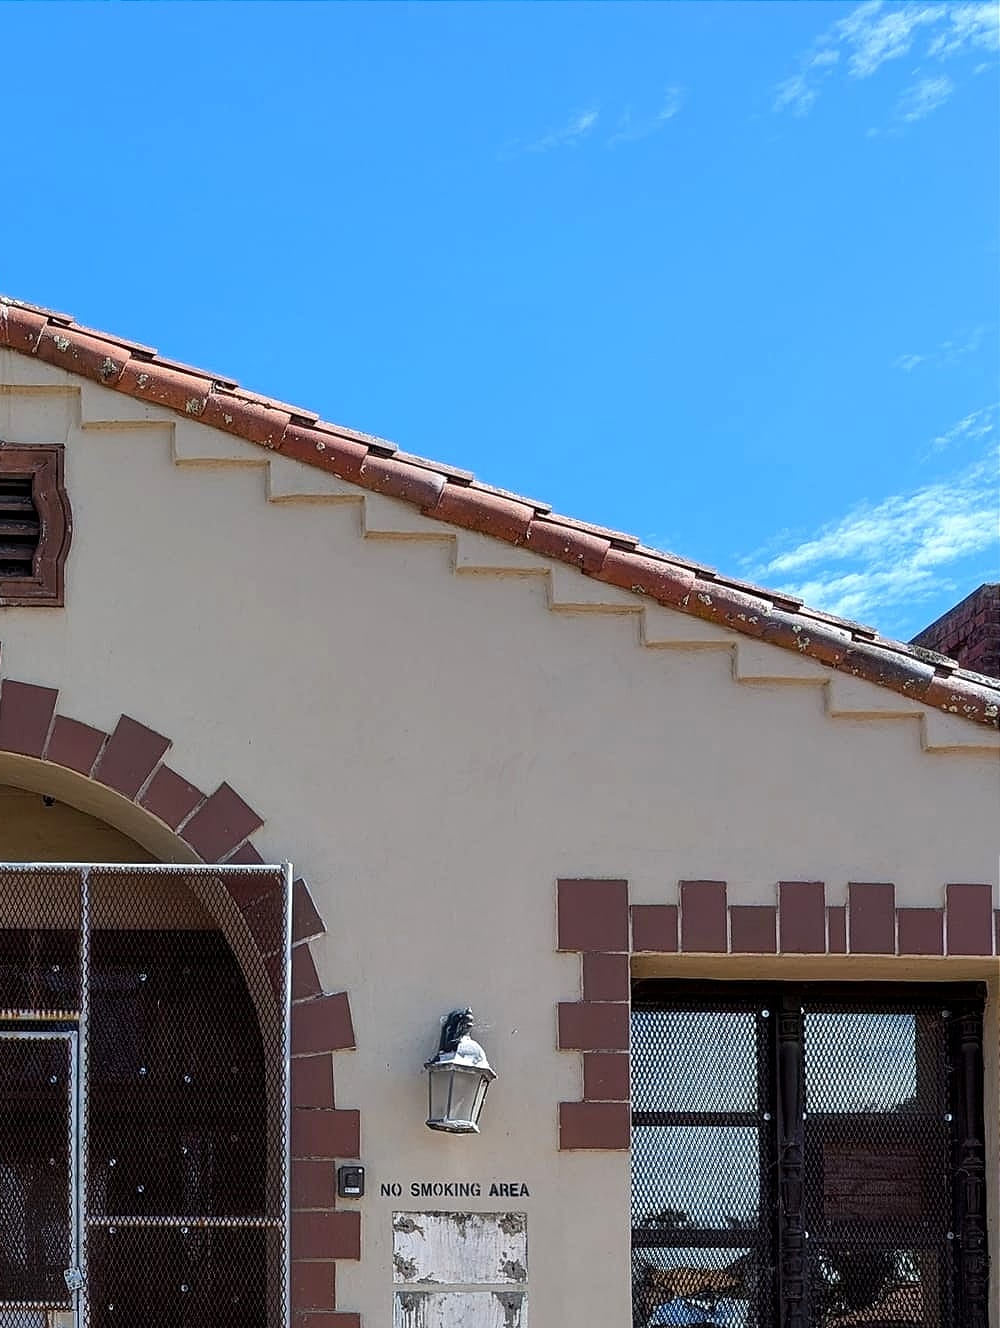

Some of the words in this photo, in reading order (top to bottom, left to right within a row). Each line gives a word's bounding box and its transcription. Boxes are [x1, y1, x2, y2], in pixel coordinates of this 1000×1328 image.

[381, 1183, 402, 1197] NO
[411, 1182, 481, 1197] SMOKING
[489, 1182, 530, 1197] AREA
